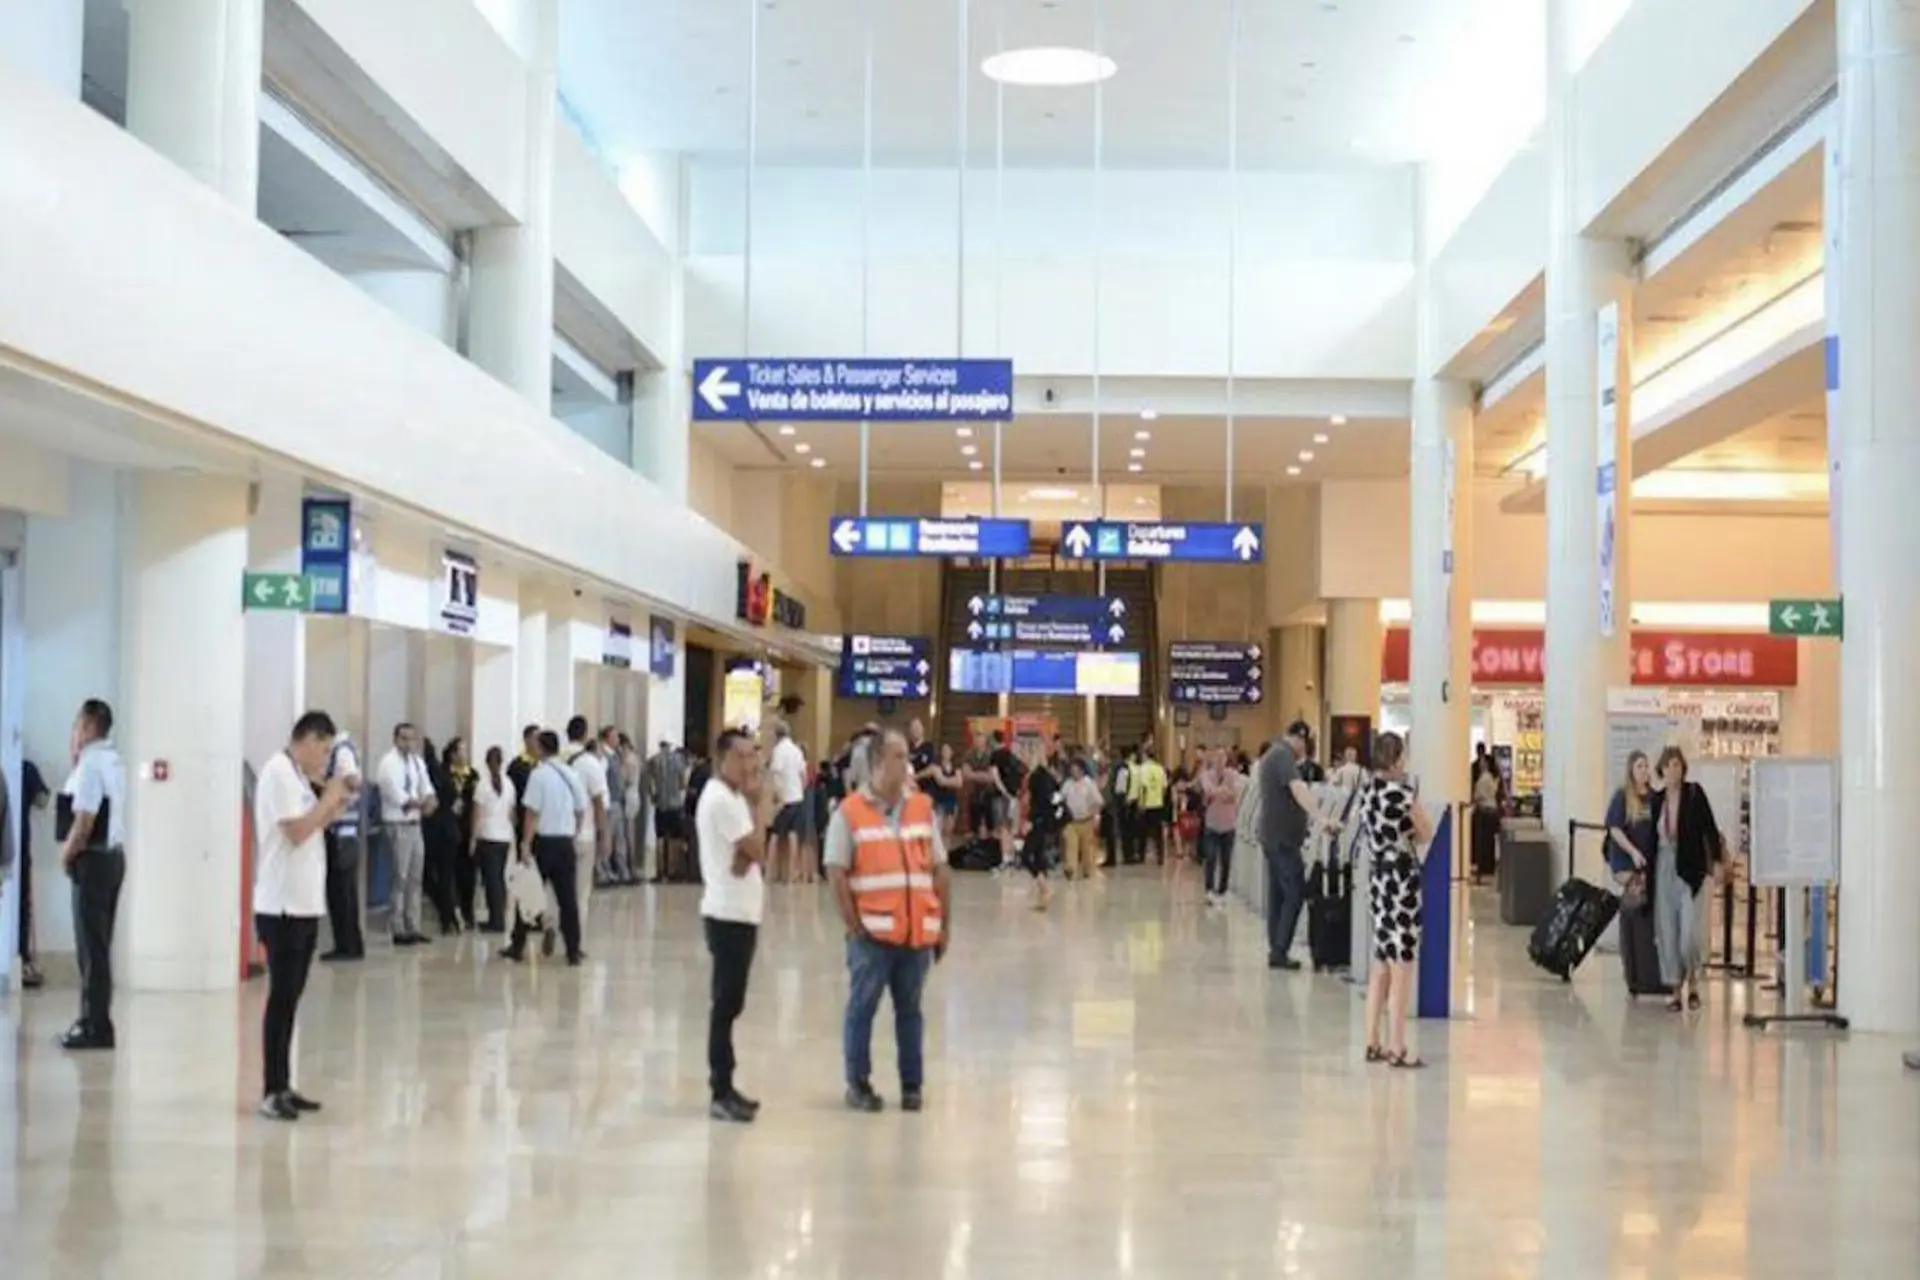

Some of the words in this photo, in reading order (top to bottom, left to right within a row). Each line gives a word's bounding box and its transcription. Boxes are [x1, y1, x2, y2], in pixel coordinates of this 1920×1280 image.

[748, 363, 785, 385] Ticket
[787, 363, 820, 385] Sales
[823, 362, 835, 384] &
[837, 363, 901, 390] Passenger
[903, 363, 957, 386] Services
[747, 389, 788, 411] Venta
[790, 389, 808, 410] de
[809, 389, 861, 410] boletos
[863, 395, 873, 415] y
[875, 388, 934, 411] servicios
[935, 389, 949, 410] al
[950, 388, 1009, 414] pasajero
[1664, 640, 1754, 678] STORE
